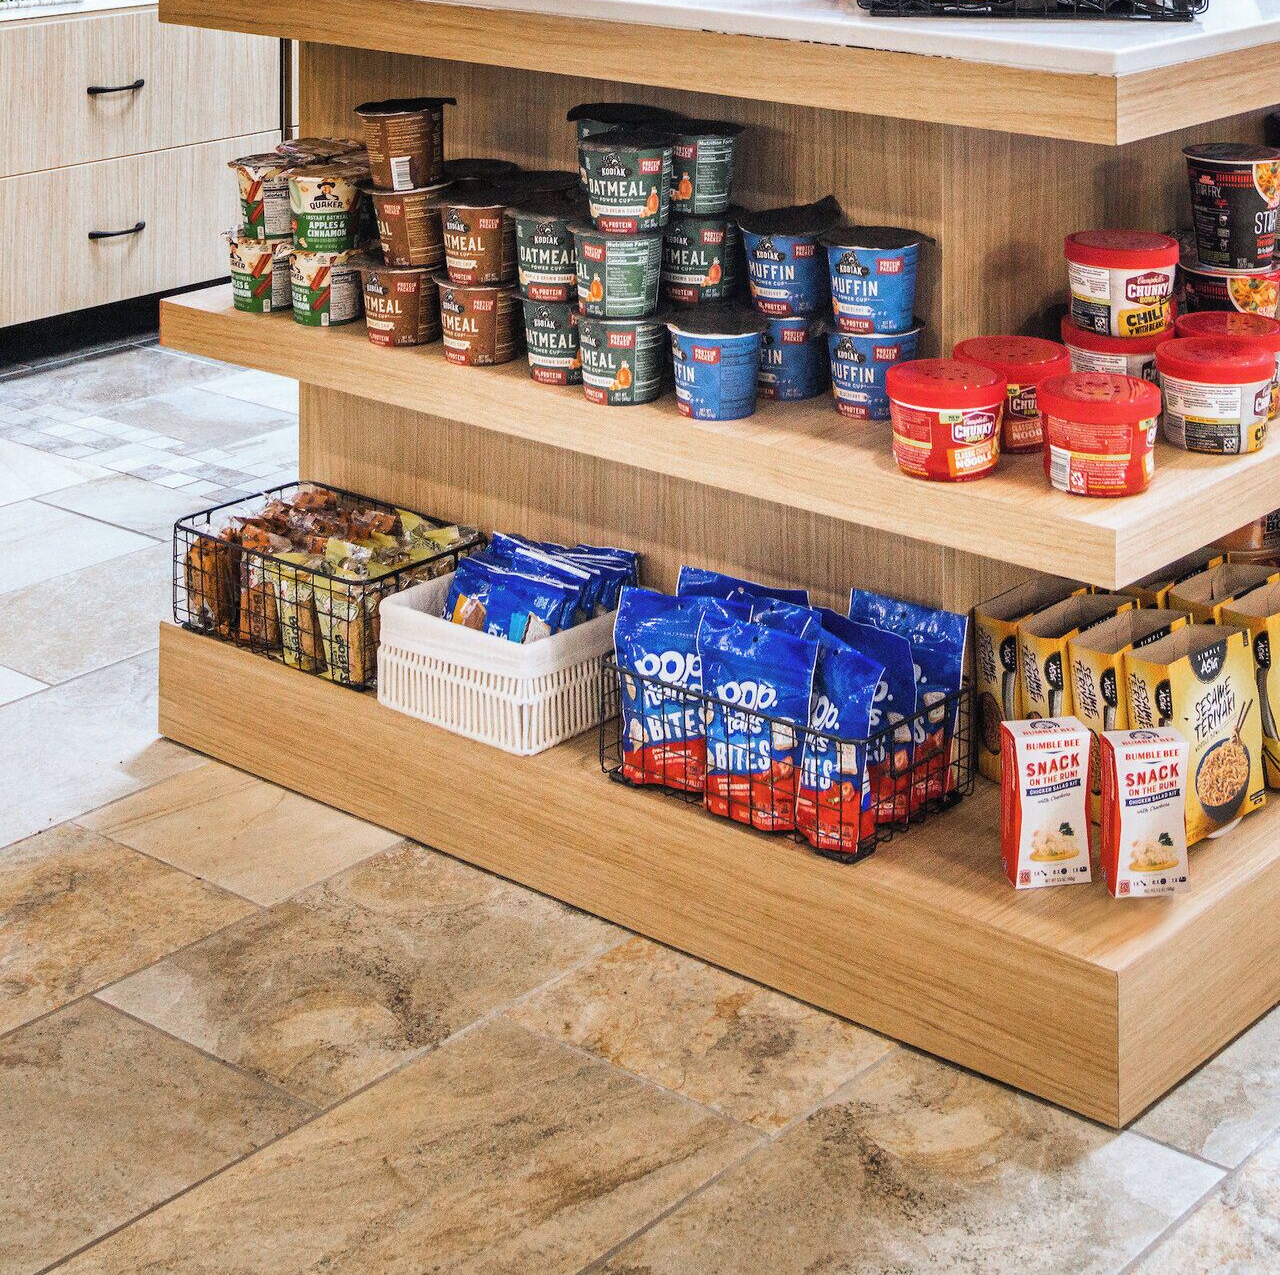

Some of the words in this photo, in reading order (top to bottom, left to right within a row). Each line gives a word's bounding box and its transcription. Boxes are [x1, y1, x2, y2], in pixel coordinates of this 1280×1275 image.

[602, 168, 625, 176] KODIAK
[589, 181, 647, 196] OATMEAL
[309, 201, 343, 209] QUAKER
[309, 221, 337, 229] APPLES
[307, 229, 347, 237] CINNAMON
[534, 235, 558, 245] KODIAK
[521, 248, 578, 265] OATMEAL
[749, 262, 795, 280] MUFFIN
[839, 265, 863, 276] KODIAK
[832, 277, 878, 296] MUFFIN
[1128, 284, 1168, 297] CHUNKY
[1127, 307, 1163, 326] CHILI
[831, 362, 875, 383] MUFFIN
[955, 422, 993, 438] CHUNKY
[956, 452, 992, 469] NOODLE
[1197, 646, 1220, 660] SIMPLY
[1195, 676, 1231, 721] SESAME
[1195, 693, 1236, 743] TERIYAKI
[1026, 740, 1062, 750] BUMBLE
[1064, 739, 1080, 747] BEE
[715, 740, 770, 770] BITES
[1125, 751, 1161, 760] BUMBLE
[1163, 749, 1180, 757] BEE
[1026, 752, 1080, 777] SNACK
[1029, 777, 1040, 786] ON
[1043, 775, 1057, 784] THE
[1060, 771, 1078, 781] RUN!
[1126, 763, 1179, 787] SNACK
[1129, 788, 1140, 796] ON
[1142, 785, 1156, 794] THE
[1159, 781, 1177, 791] RUN!
